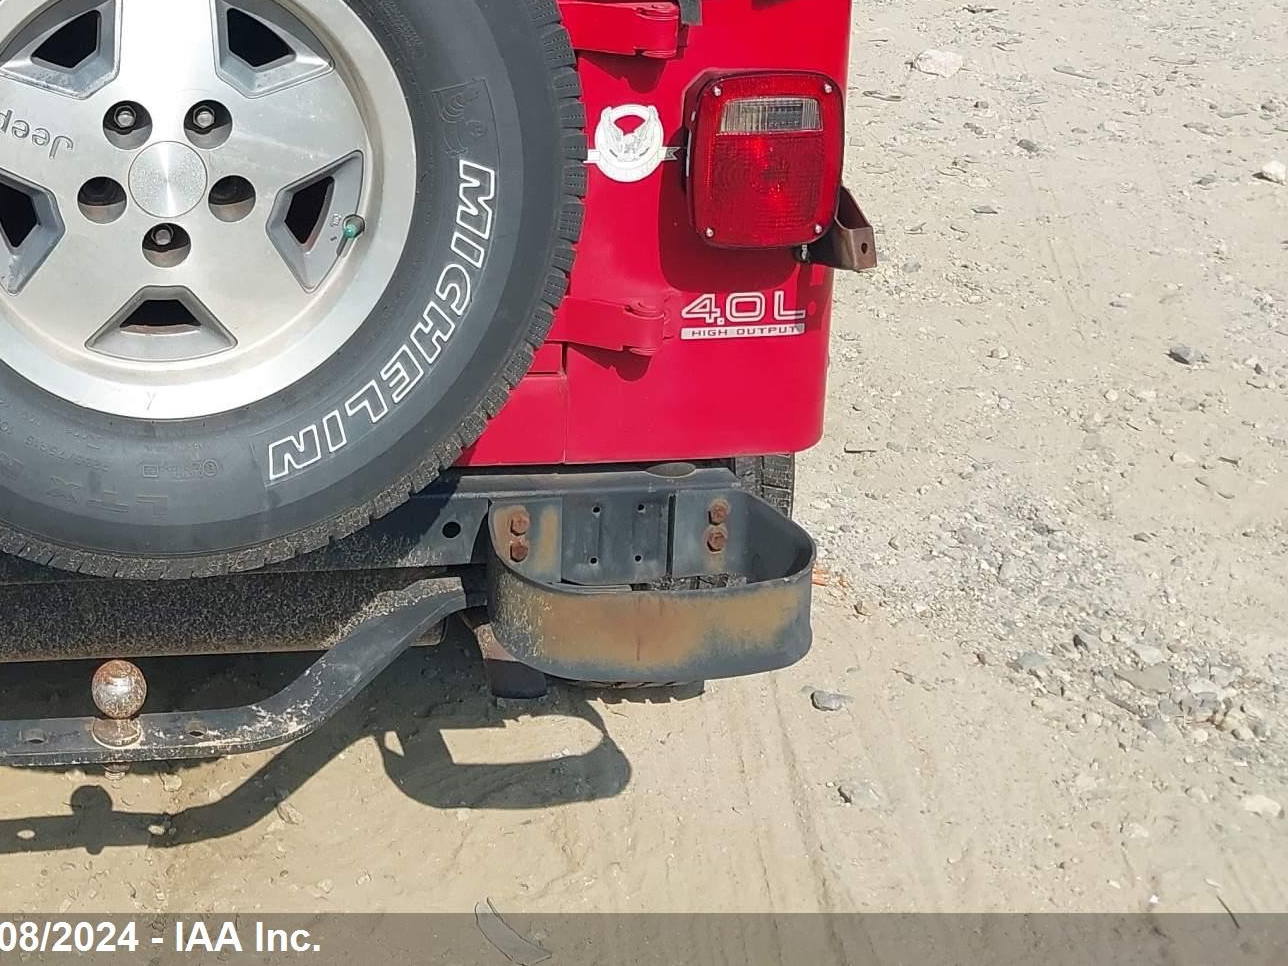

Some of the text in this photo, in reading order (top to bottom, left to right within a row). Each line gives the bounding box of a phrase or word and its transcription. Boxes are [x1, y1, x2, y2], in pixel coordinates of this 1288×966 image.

[268, 157, 495, 482] MICHELIN
[681, 290, 806, 325] 4.0L
[691, 325, 798, 338] HIGH OUTPUT
